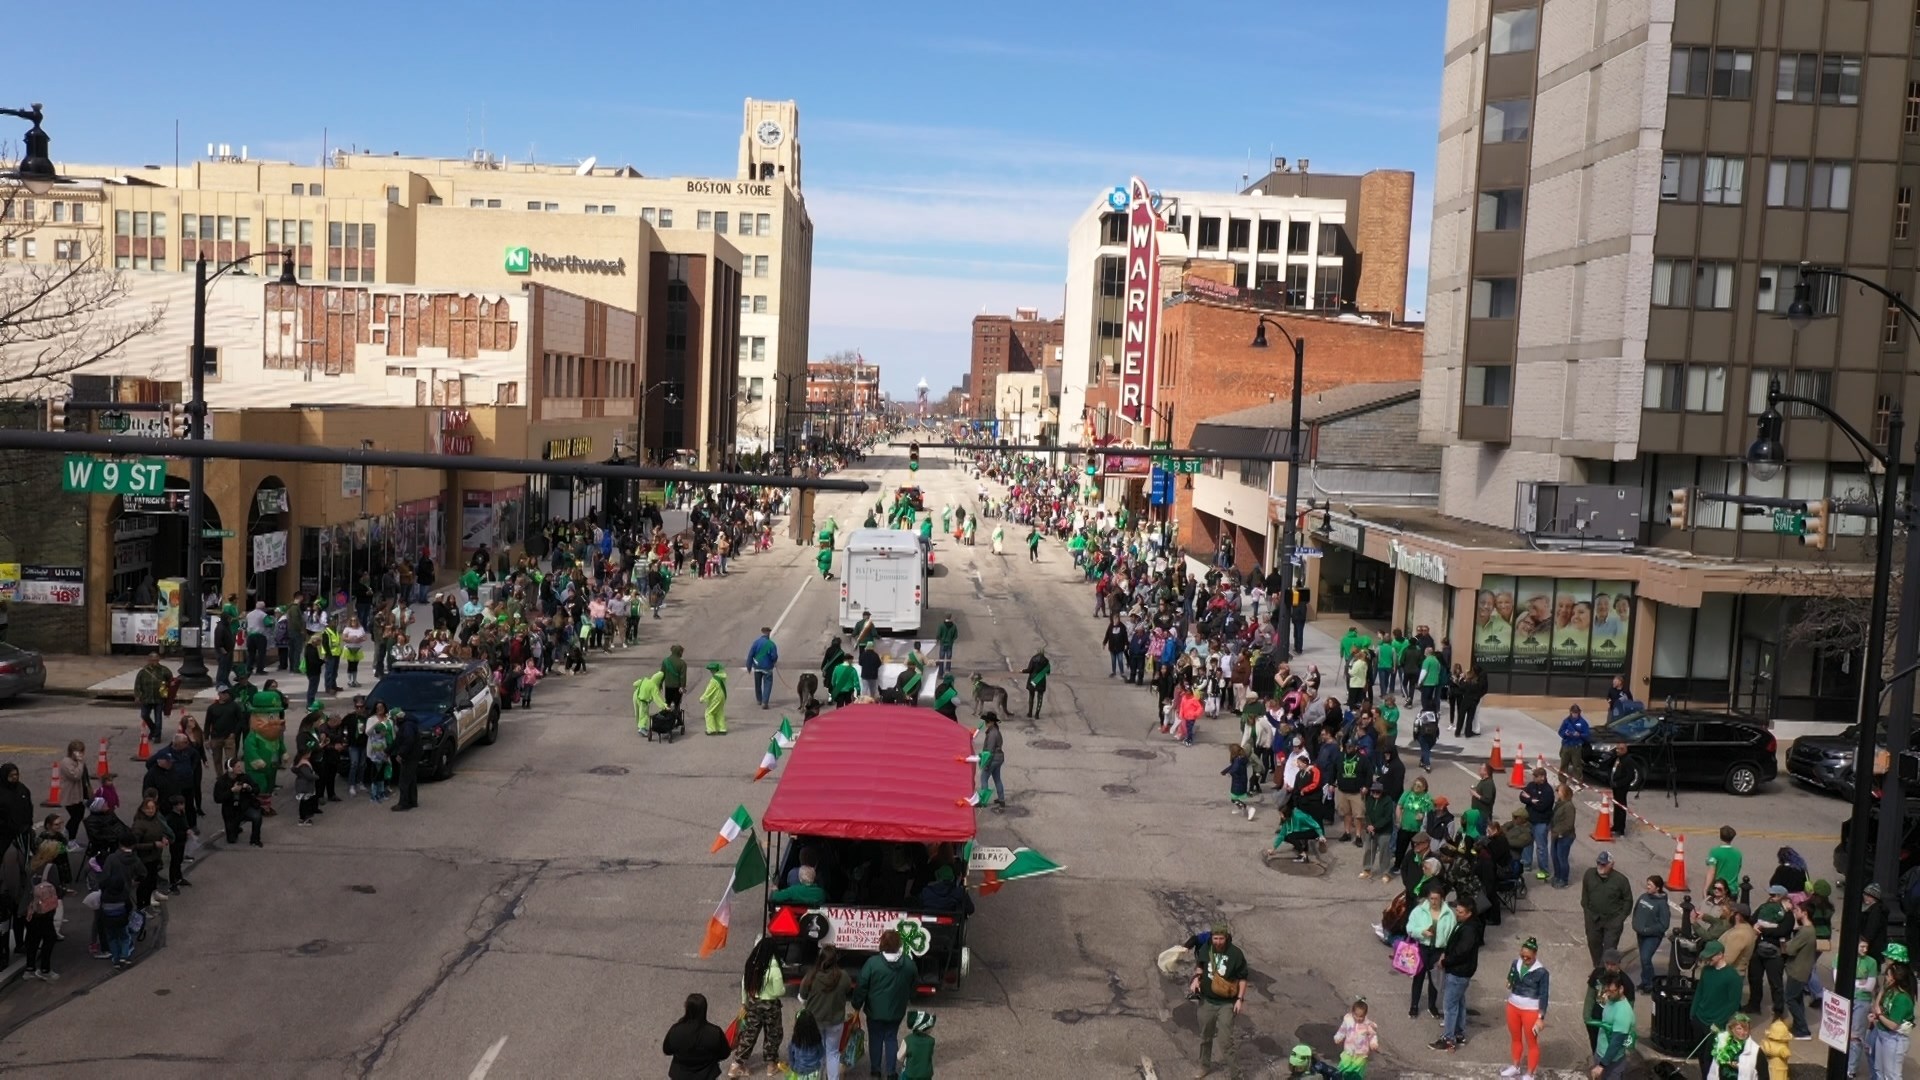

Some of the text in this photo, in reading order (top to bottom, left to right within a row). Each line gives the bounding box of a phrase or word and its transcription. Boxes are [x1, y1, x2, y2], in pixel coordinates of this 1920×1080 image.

[687, 181, 771, 196] BOSTON STORE
[533, 253, 626, 275] Northwest
[1123, 224, 1150, 407] WARNER
[550, 439, 571, 460] DOLLAR
[1162, 460, 1169, 471] E
[1173, 460, 1181, 472] 9
[1185, 460, 1200, 472] ST
[69, 461, 162, 490] W 9 ST
[1774, 513, 1795, 531] STATE
[54, 568, 81, 577] ULTRA
[827, 907, 900, 922] MAY FARM
